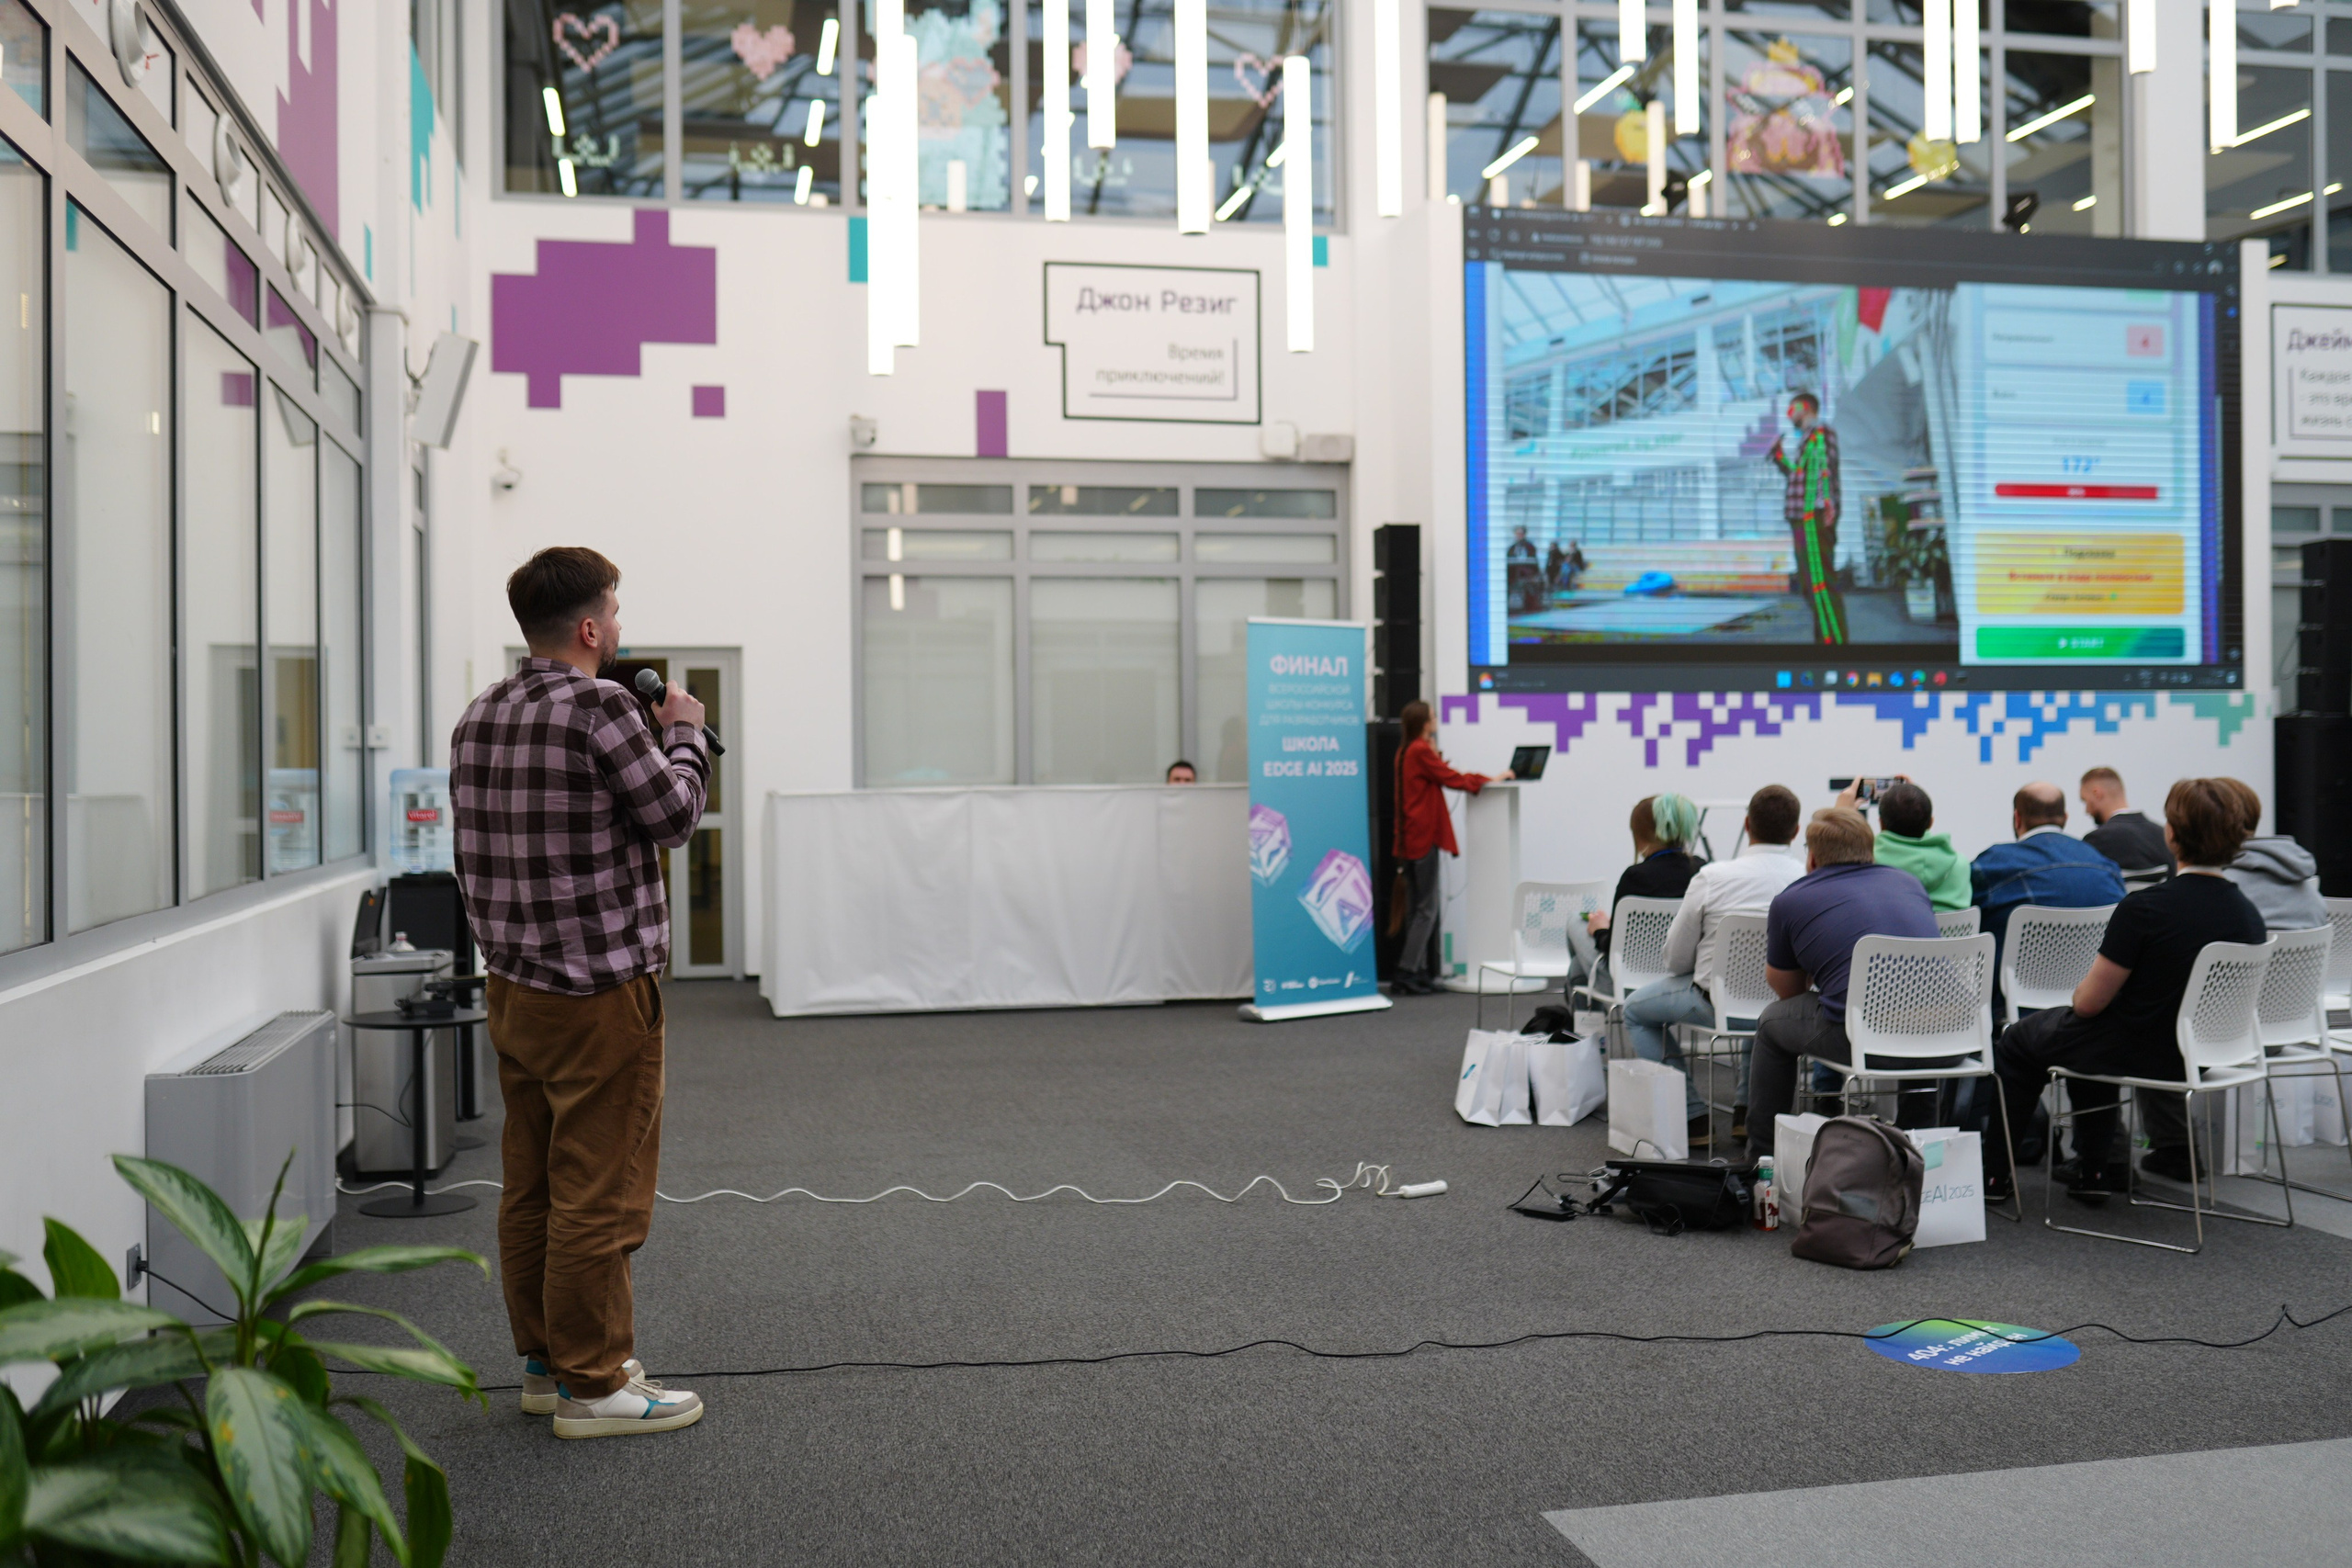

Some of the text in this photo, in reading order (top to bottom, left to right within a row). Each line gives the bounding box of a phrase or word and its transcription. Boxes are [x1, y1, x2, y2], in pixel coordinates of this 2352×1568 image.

[1076, 287, 1238, 314] Джон Резиг
[1168, 344, 1224, 361] Время
[1096, 368, 1225, 386] приключений!
[1270, 654, 1348, 677] ФИНАЛ
[1282, 736, 1340, 752] ШКОЛА
[1263, 760, 1359, 777] EDGE AI 2025
[1943, 1355, 1973, 1366] не
